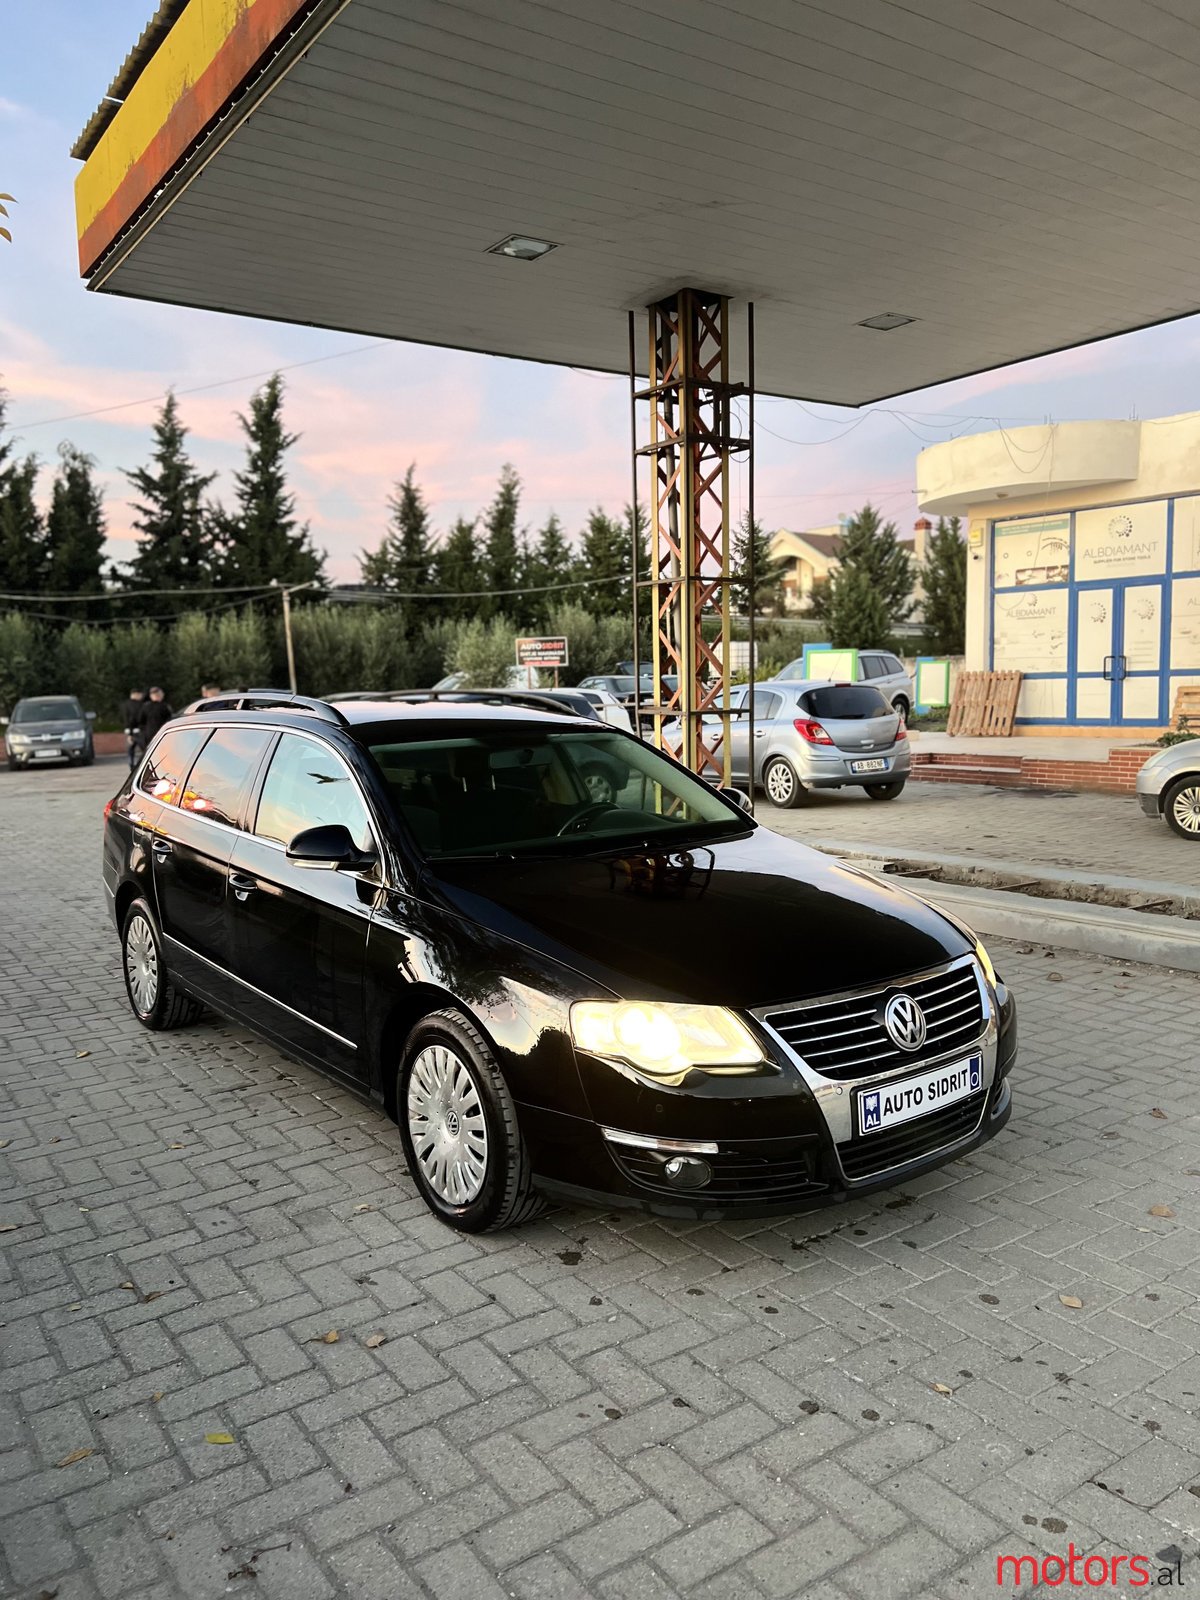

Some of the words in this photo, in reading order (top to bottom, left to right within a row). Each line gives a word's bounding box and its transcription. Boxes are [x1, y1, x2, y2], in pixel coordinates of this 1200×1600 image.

[1083, 541, 1158, 559] ALBDIAMANT
[1006, 607, 1056, 618] ALBDIAMANT
[883, 1086, 923, 1116] AUTO
[928, 1068, 968, 1101] SIDRIT
[866, 1113, 880, 1128] AL
